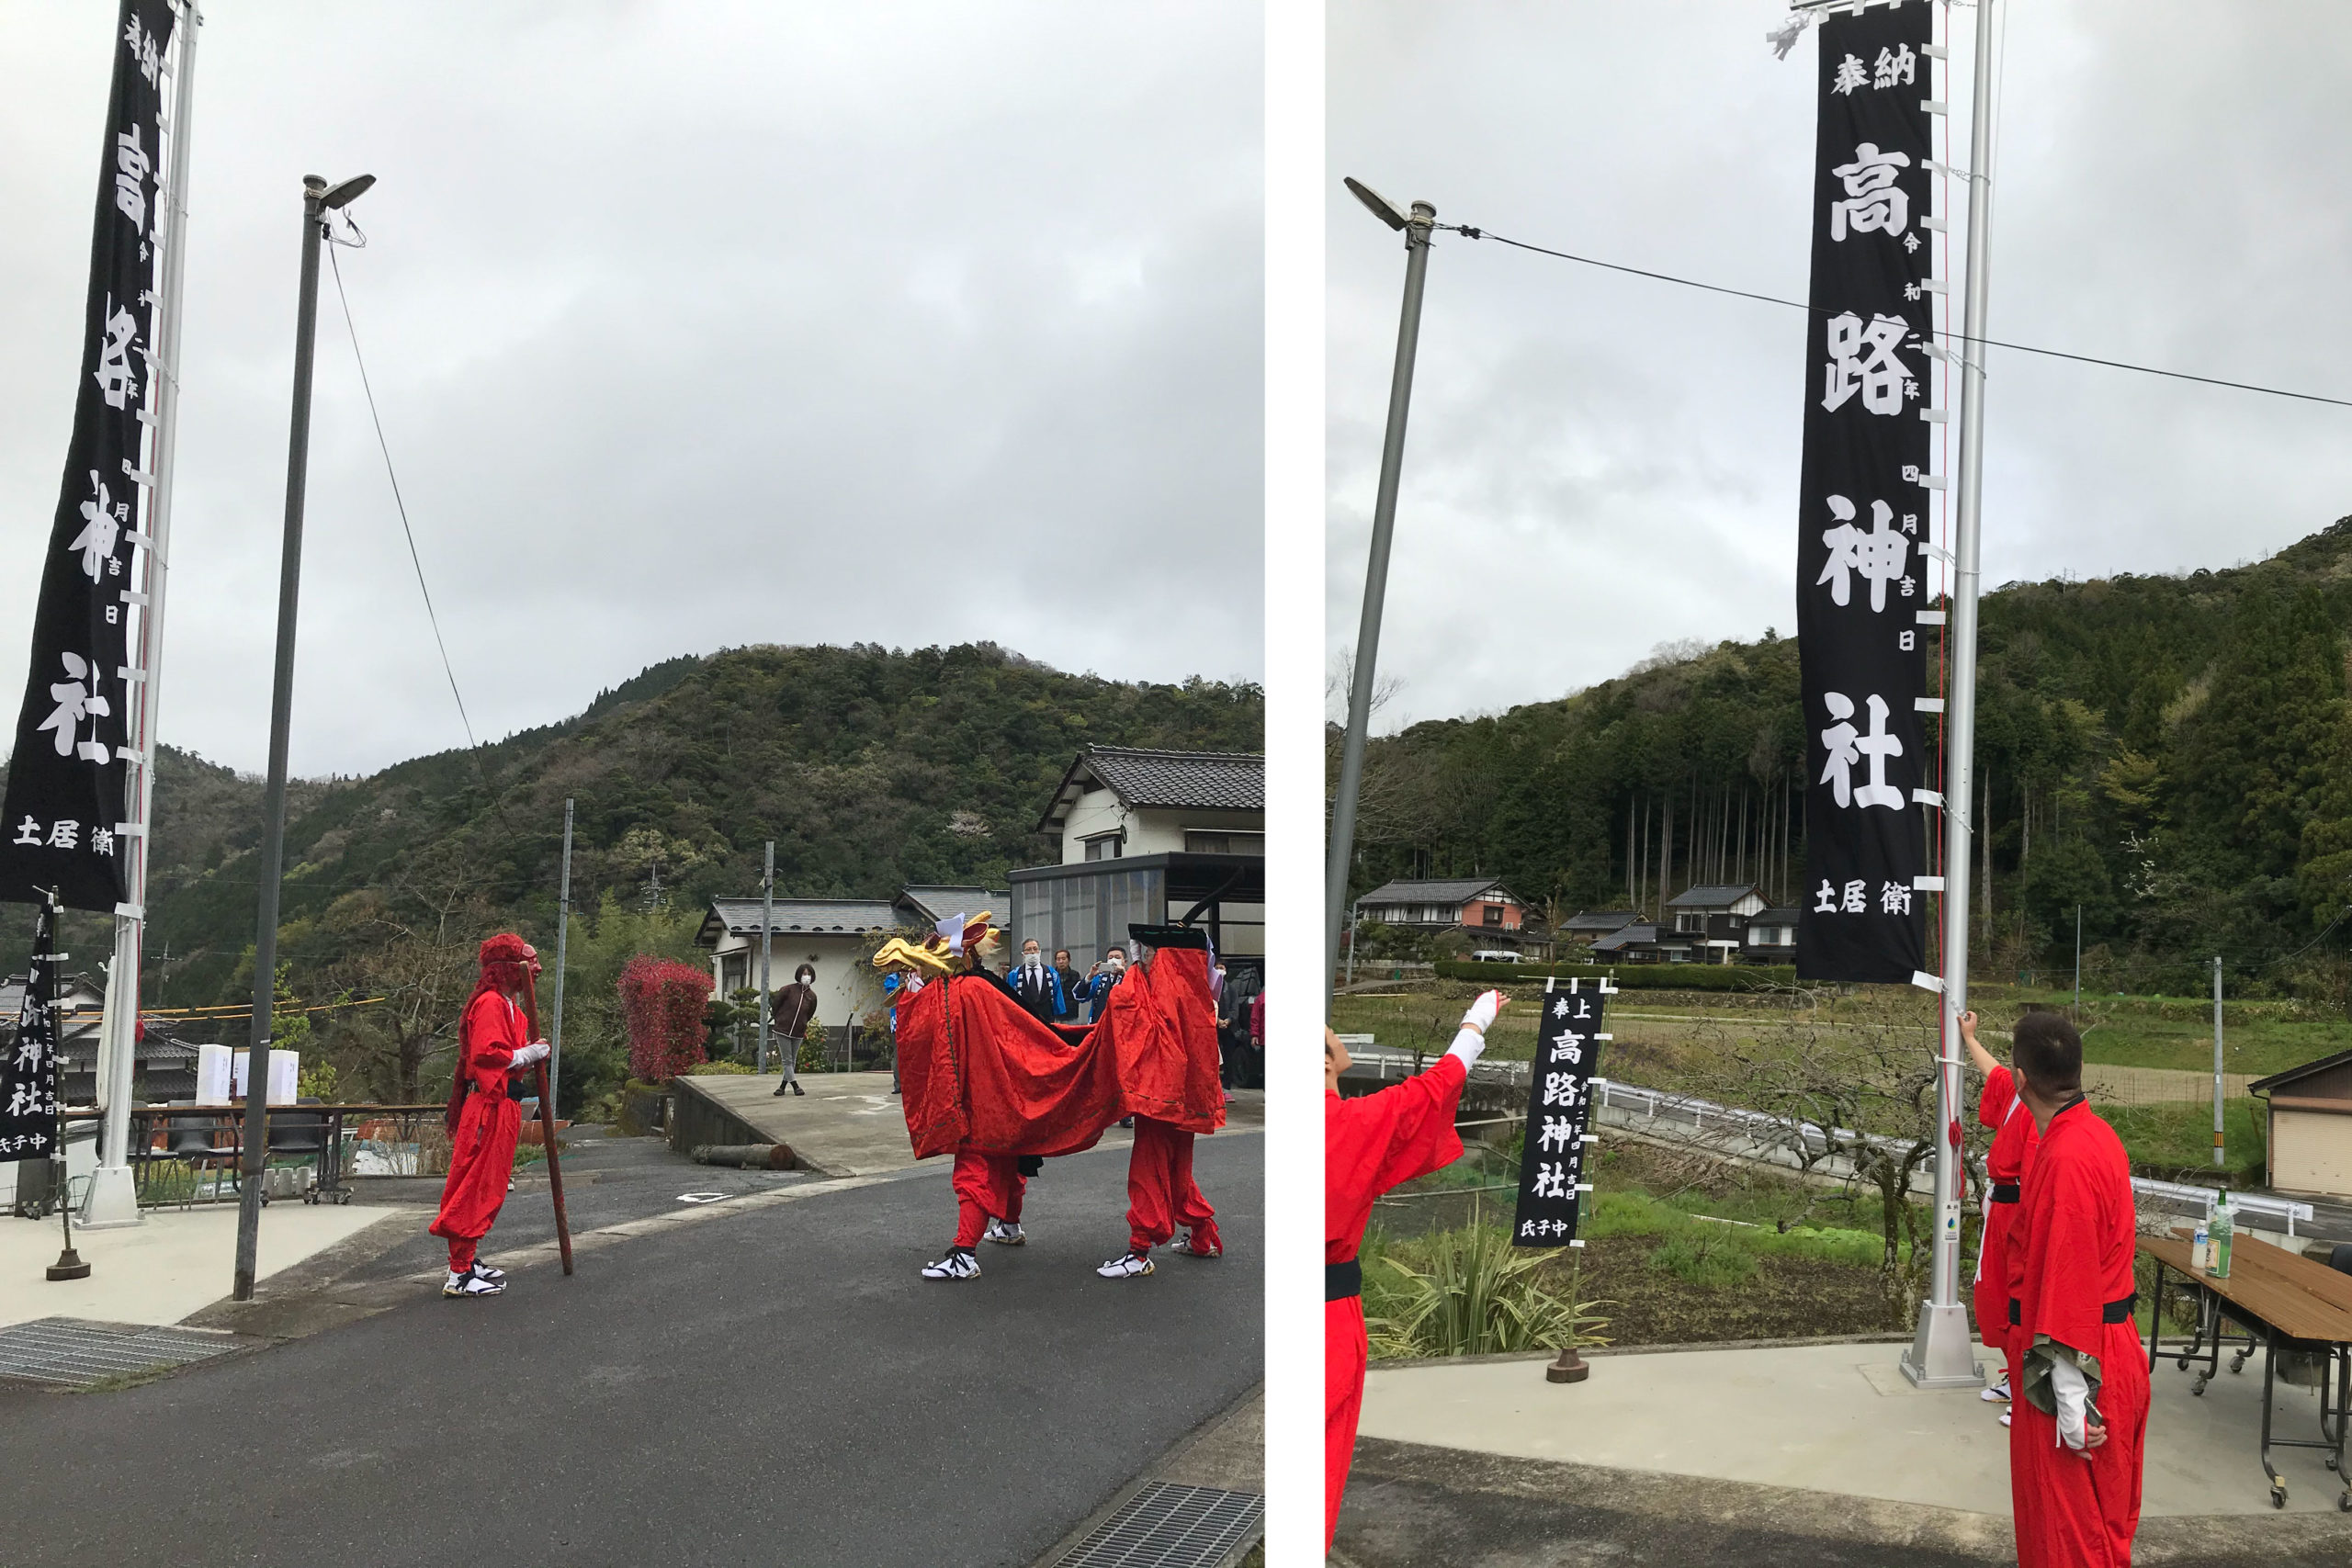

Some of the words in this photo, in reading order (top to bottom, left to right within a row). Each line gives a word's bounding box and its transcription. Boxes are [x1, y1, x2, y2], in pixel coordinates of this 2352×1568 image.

[1830, 42, 1917, 96] 奉納
[36, 122, 151, 766] 高路神社
[1815, 141, 1916, 811] 高路神社
[1898, 231, 1923, 651] 令和二年四月吉日
[12, 814, 114, 857] 土居衛
[1813, 878, 1912, 916] 土居衛
[1551, 997, 1591, 1020] 奉上
[1531, 1029, 1586, 1199] 高路神社
[1566, 1080, 1589, 1201] 令和二年四月吉日
[1521, 1219, 1568, 1238] 氏子中
